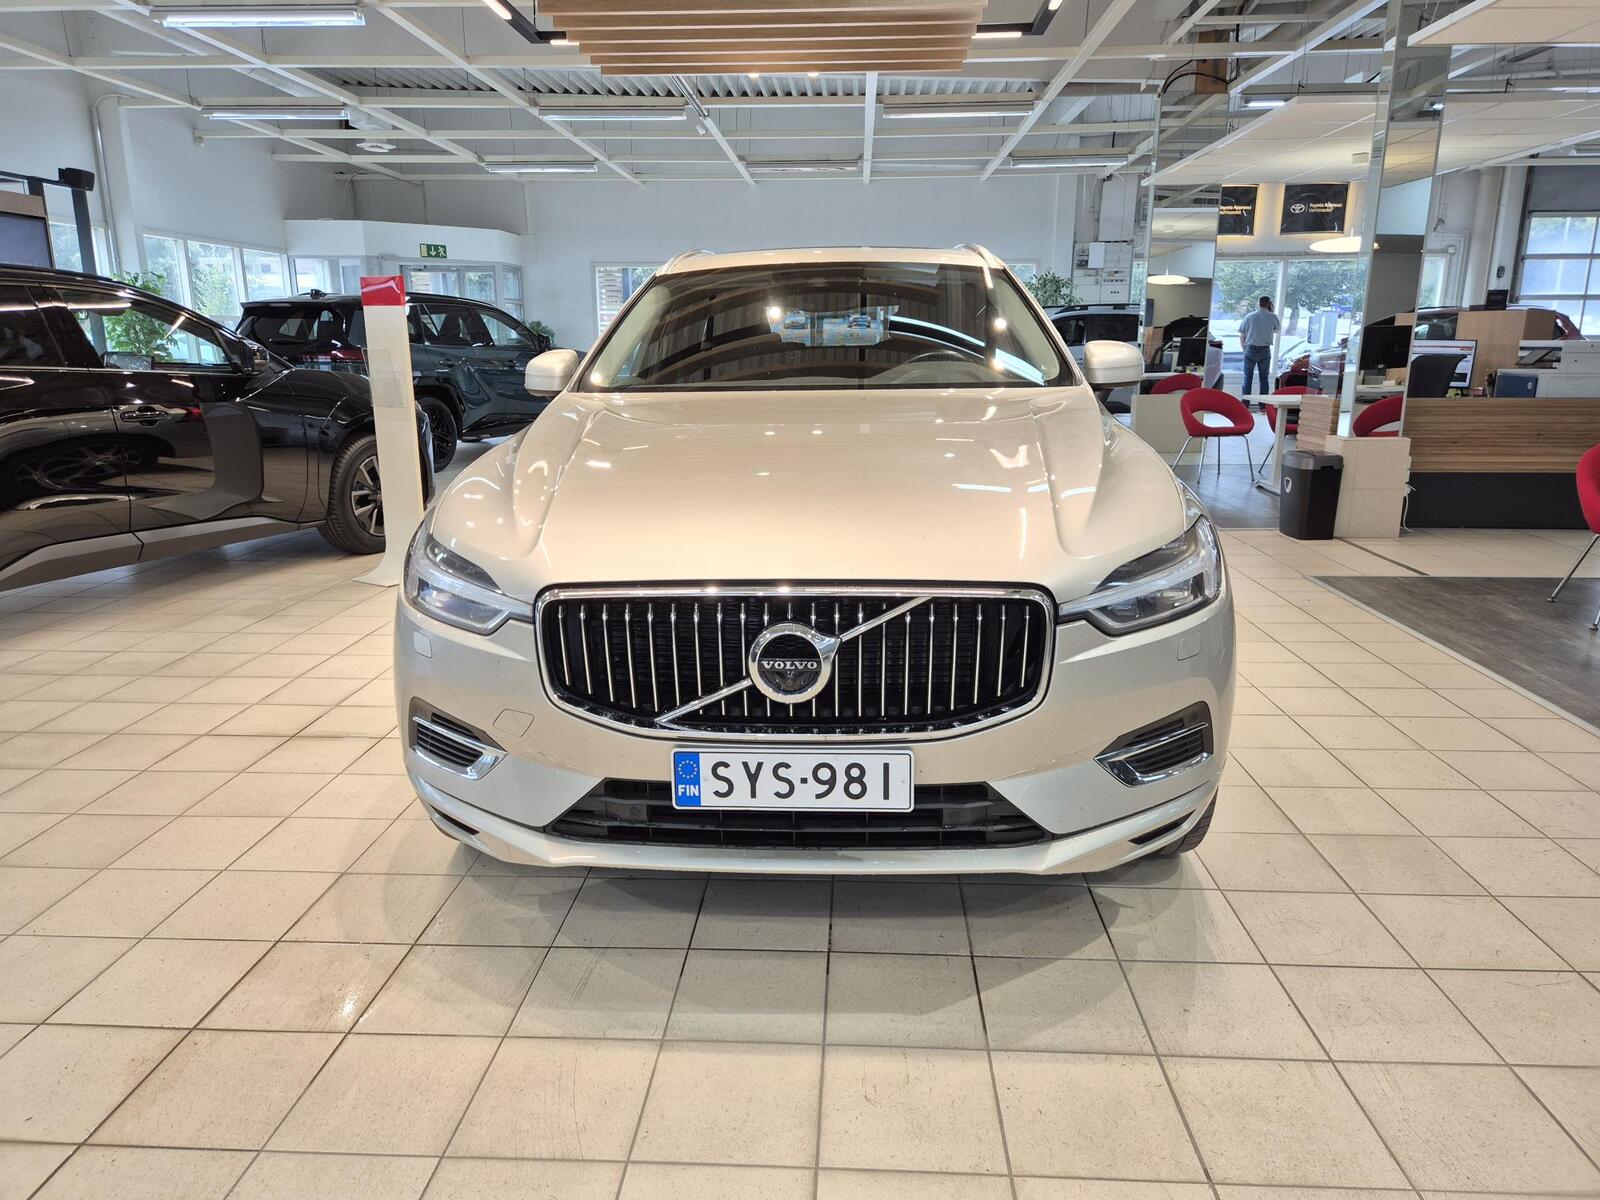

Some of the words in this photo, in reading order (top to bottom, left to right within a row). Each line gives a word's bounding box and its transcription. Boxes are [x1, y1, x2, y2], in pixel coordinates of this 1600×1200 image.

[761, 660, 818, 670] VOLVO
[711, 761, 890, 801] SYS-981
[677, 784, 700, 797] FIN
